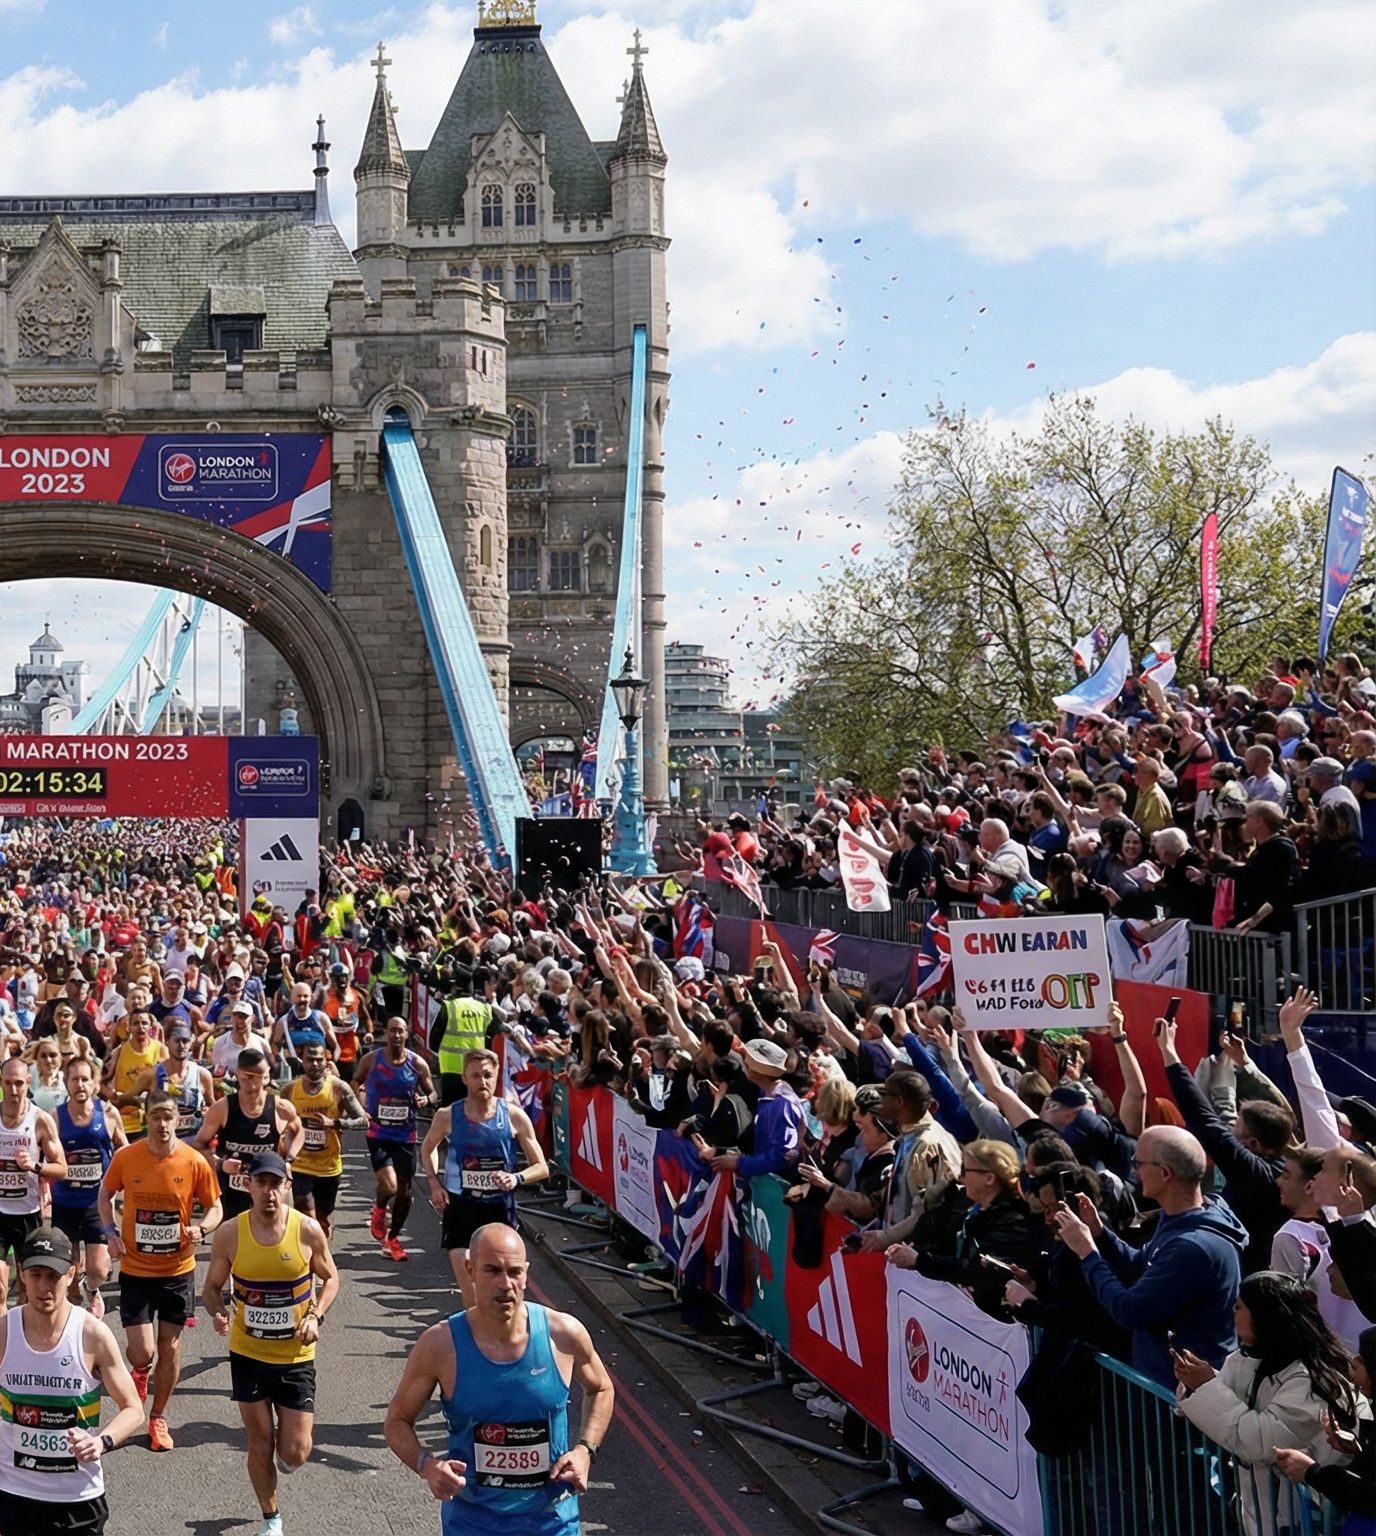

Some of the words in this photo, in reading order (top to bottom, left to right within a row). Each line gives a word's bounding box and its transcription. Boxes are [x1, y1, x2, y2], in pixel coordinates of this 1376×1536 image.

[200, 457, 254, 468] LONDON
[22, 474, 85, 493] 2023
[7, 743, 129, 760] MARATHON
[136, 744, 189, 760] 2023
[1022, 930, 1087, 952] EARAN
[934, 1341, 992, 1399] LONDON
[933, 1370, 1009, 1442] MARATHON
